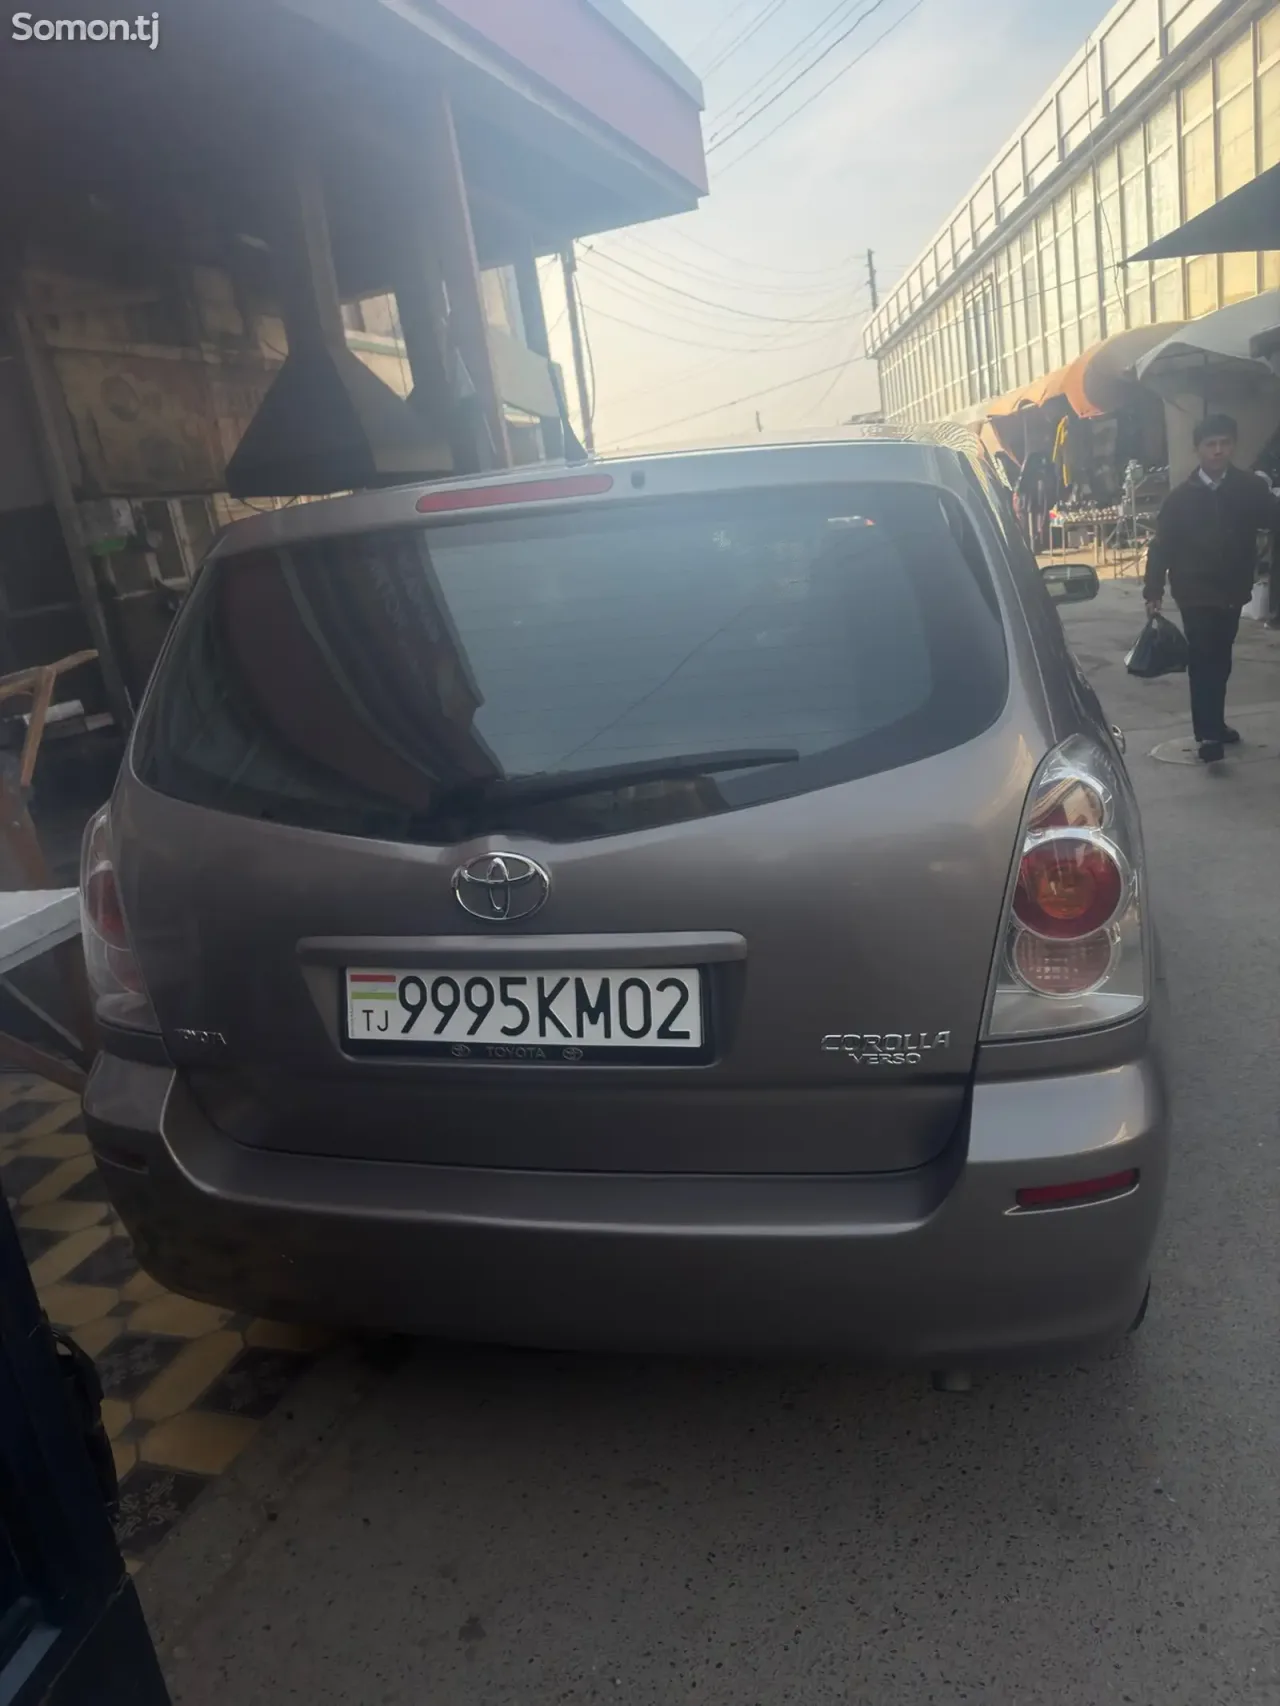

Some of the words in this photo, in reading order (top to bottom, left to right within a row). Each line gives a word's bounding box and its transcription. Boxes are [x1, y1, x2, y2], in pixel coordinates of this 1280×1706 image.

[362, 1009, 389, 1032] TJ
[398, 976, 690, 1039] 9995KM02
[821, 1031, 951, 1052] COROLLA
[486, 1046, 546, 1059] TOYOTA
[848, 1052, 921, 1065] VERSO
